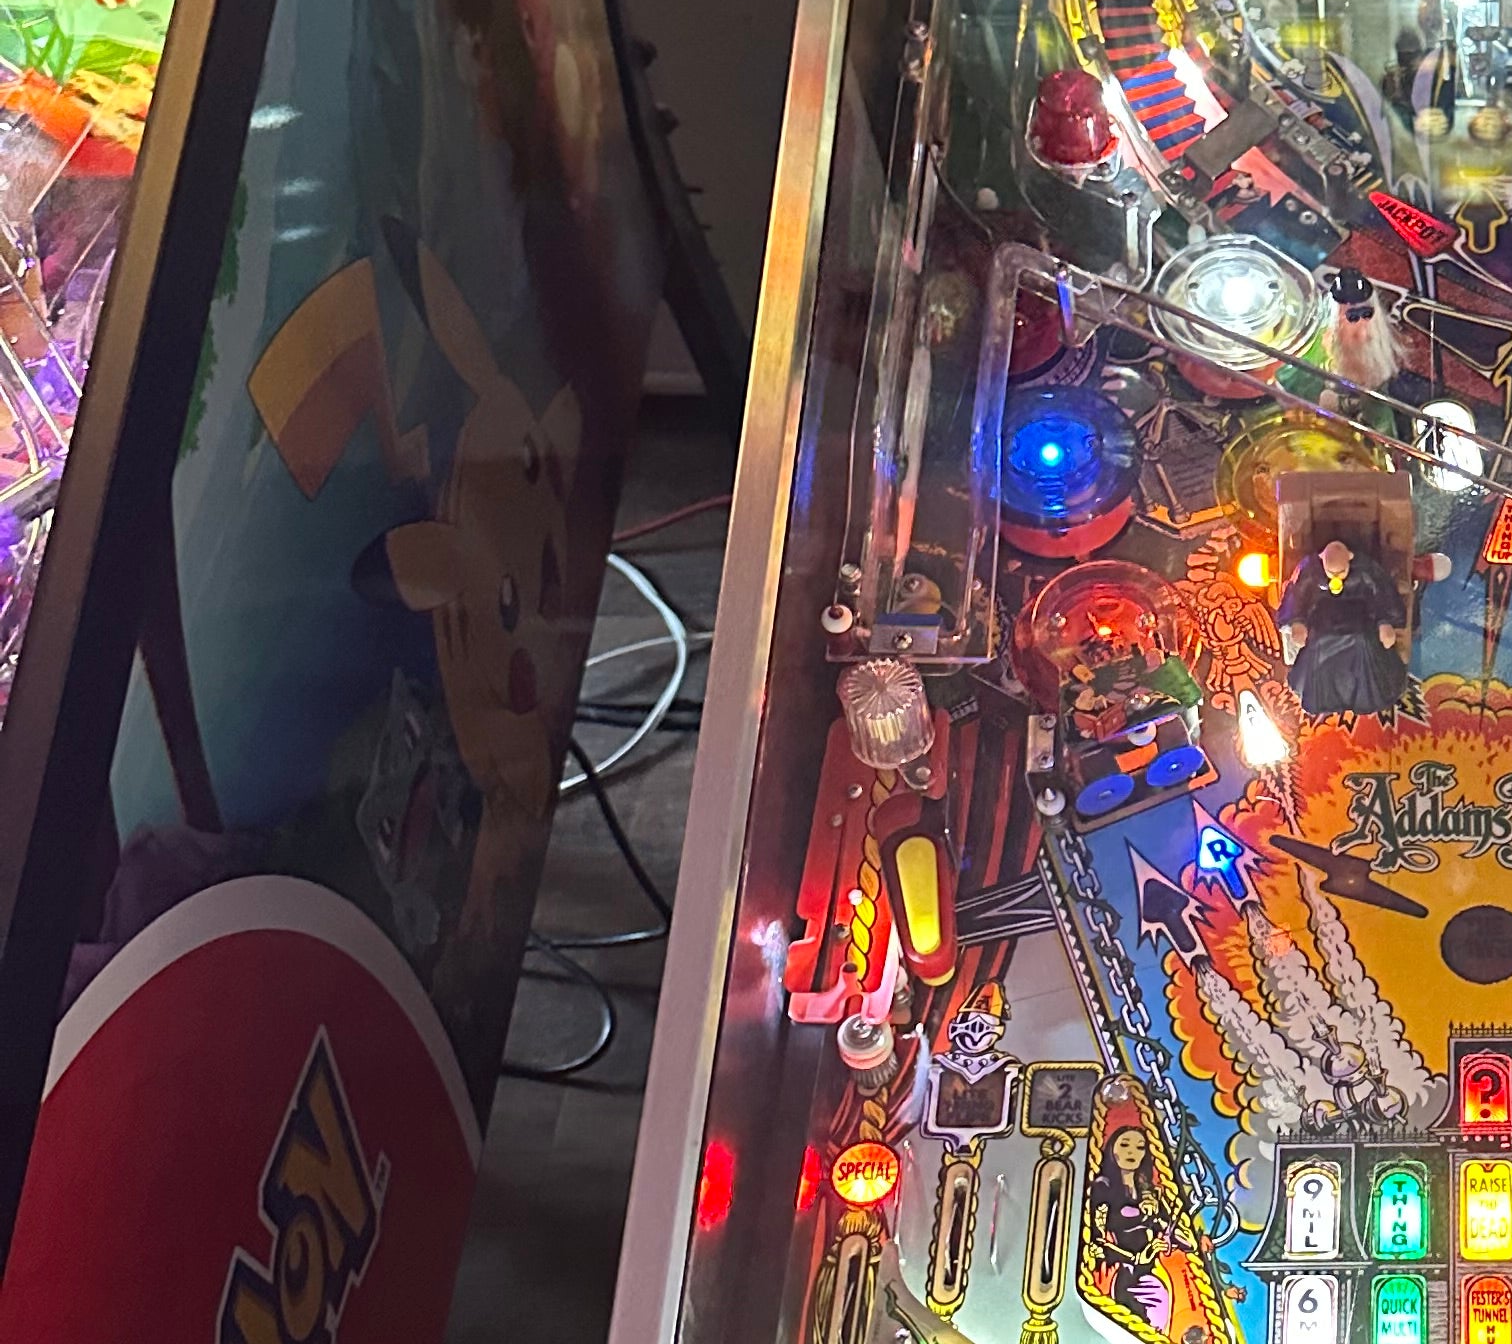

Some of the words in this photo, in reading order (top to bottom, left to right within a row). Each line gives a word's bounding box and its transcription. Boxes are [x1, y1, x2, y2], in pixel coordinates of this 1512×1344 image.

[1376, 199, 1447, 243] JACKPOT
[1409, 760, 1458, 797] The
[1207, 838, 1234, 863] R
[1058, 1083, 1074, 1099] 2
[1044, 1099, 1082, 1112] BEAR
[1040, 1112, 1083, 1125] KICKS
[838, 1162, 892, 1182] SPECIAL
[1303, 1178, 1324, 1201] 9
[1469, 1177, 1508, 1193] RAISE
[1391, 1180, 1409, 1247] THING
[1298, 1287, 1319, 1314] 6
[1381, 1298, 1418, 1315] QUICK
[1471, 1289, 1512, 1307] FESTER'S
[1472, 1308, 1509, 1324] TUNNEL
